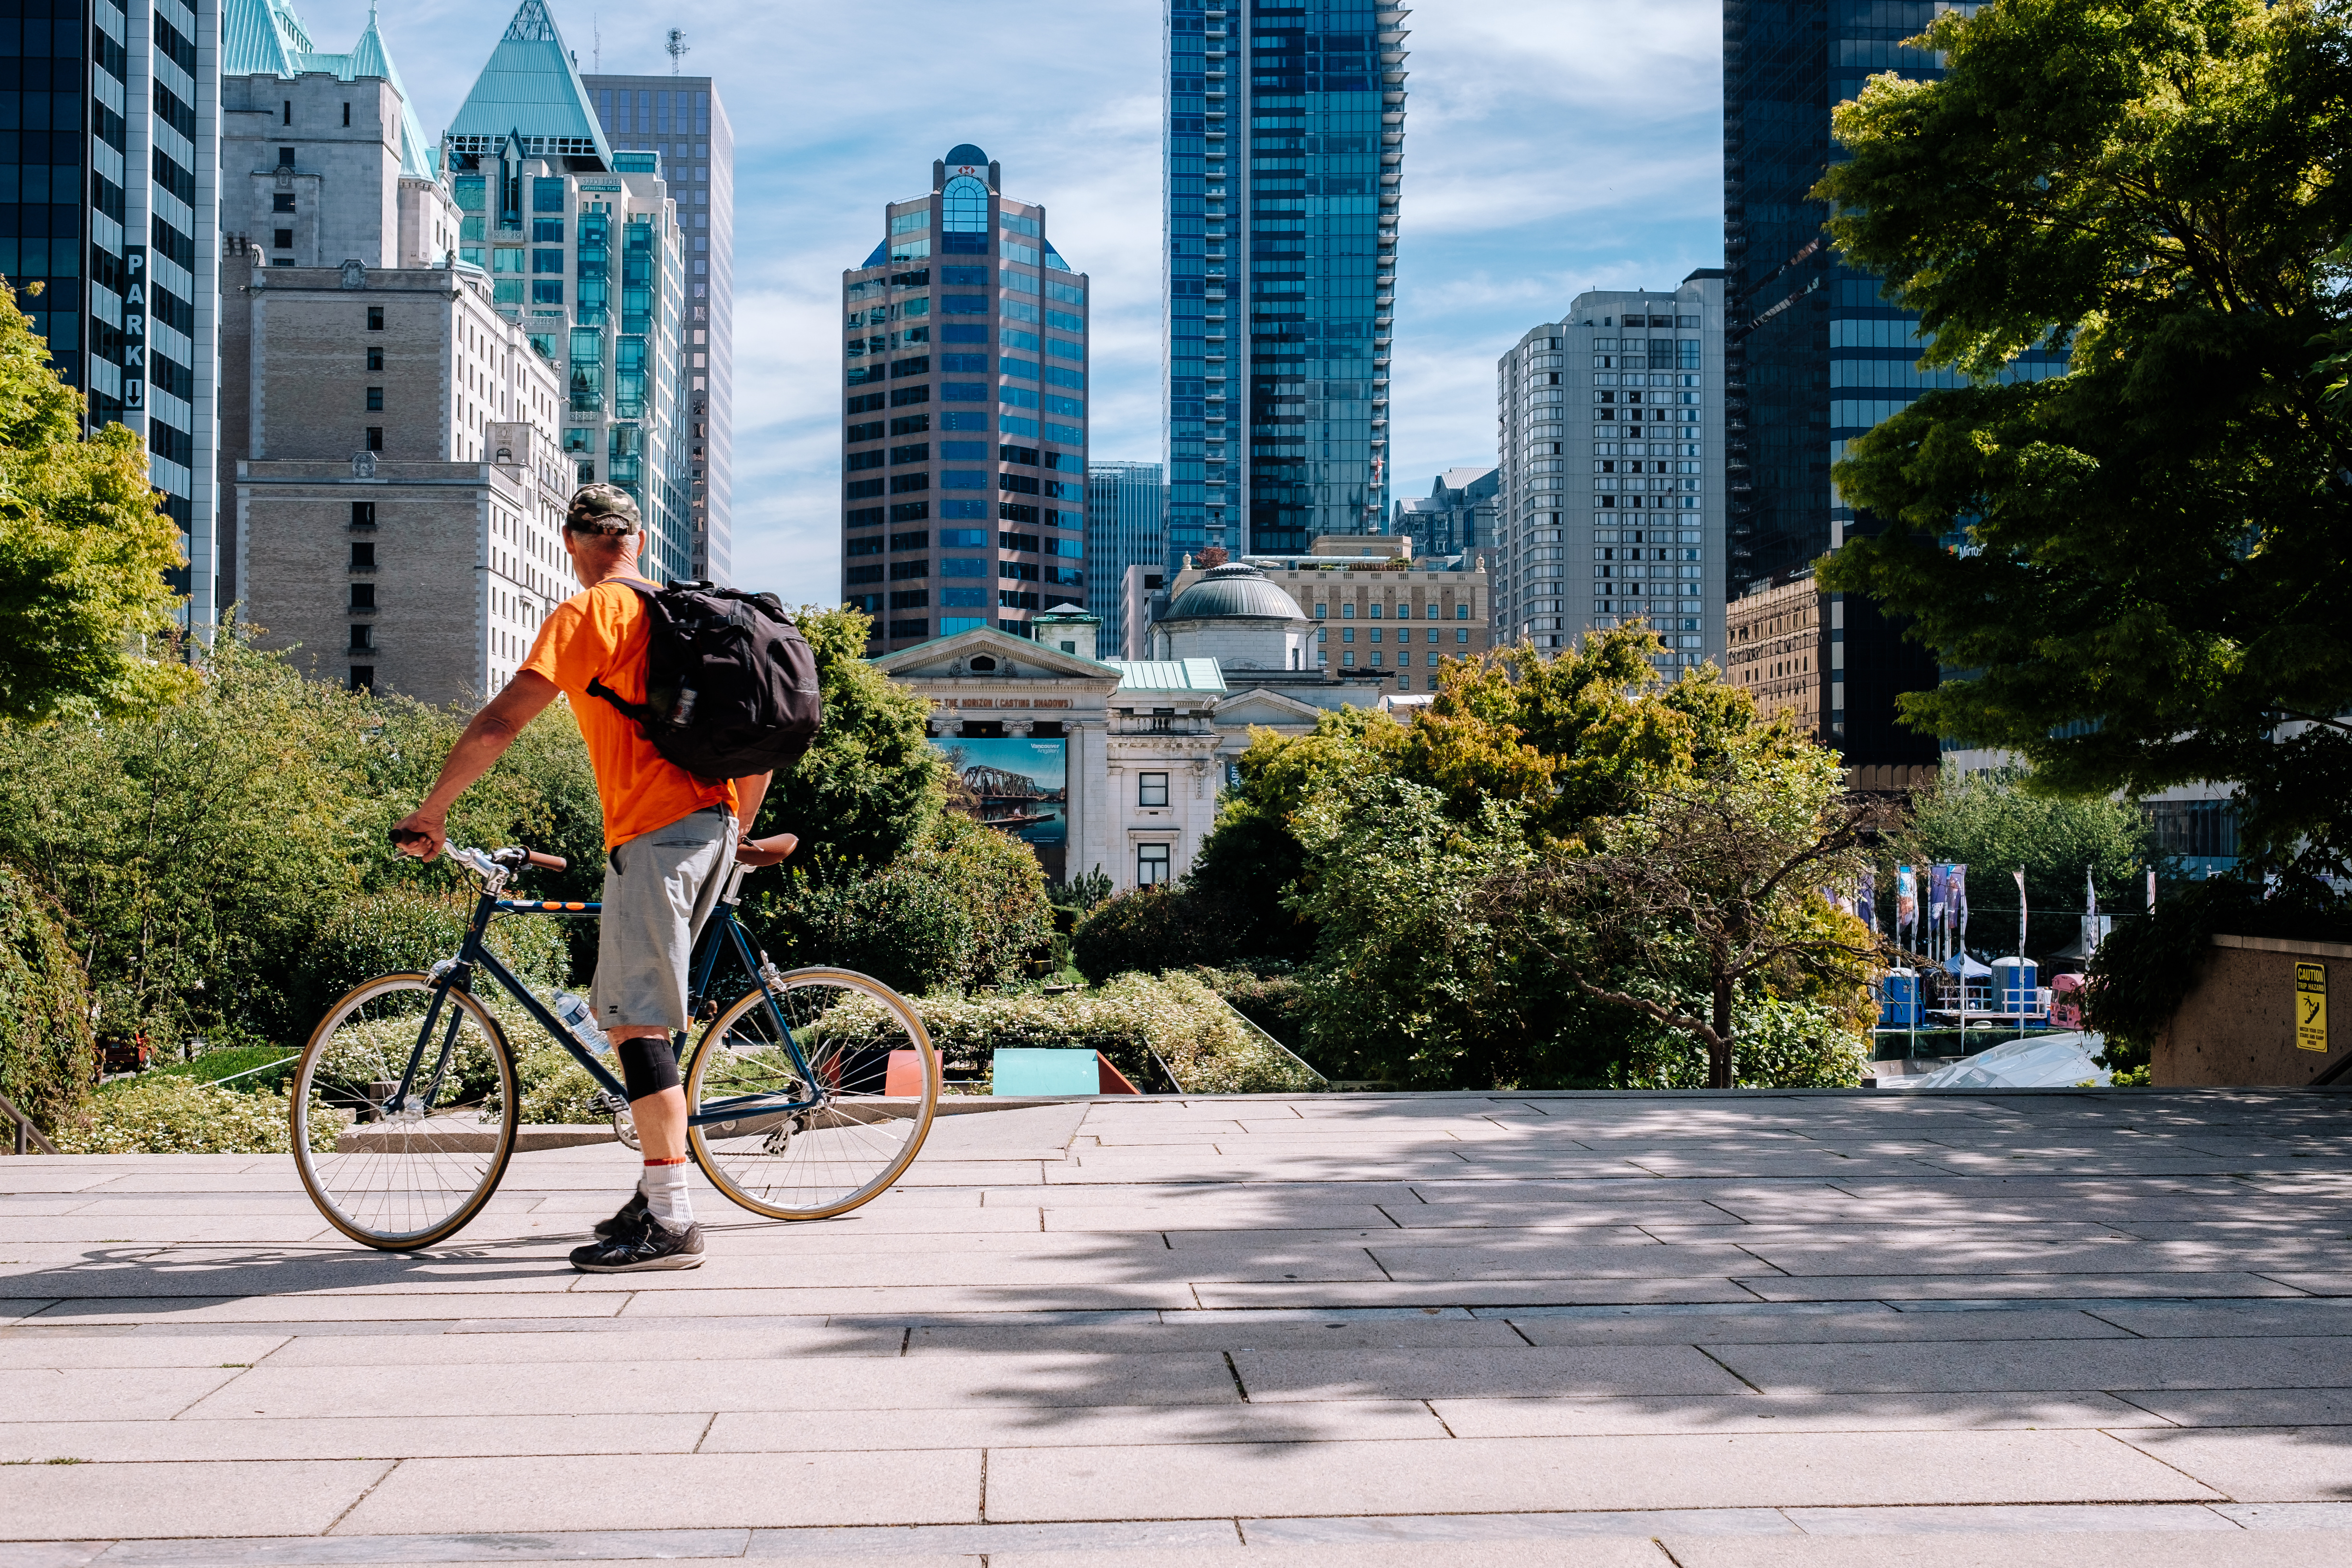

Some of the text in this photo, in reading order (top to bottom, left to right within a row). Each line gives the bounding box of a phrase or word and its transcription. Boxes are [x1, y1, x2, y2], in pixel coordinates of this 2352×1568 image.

[126, 254, 145, 367] PARK
[944, 698, 958, 707] THE
[962, 698, 993, 708] HORIZON
[995, 698, 1030, 709] (CASTING
[1034, 698, 1074, 709] SHADOWS)
[2298, 968, 2323, 982] CAUTION
[2308, 983, 2324, 992] HAZARD
